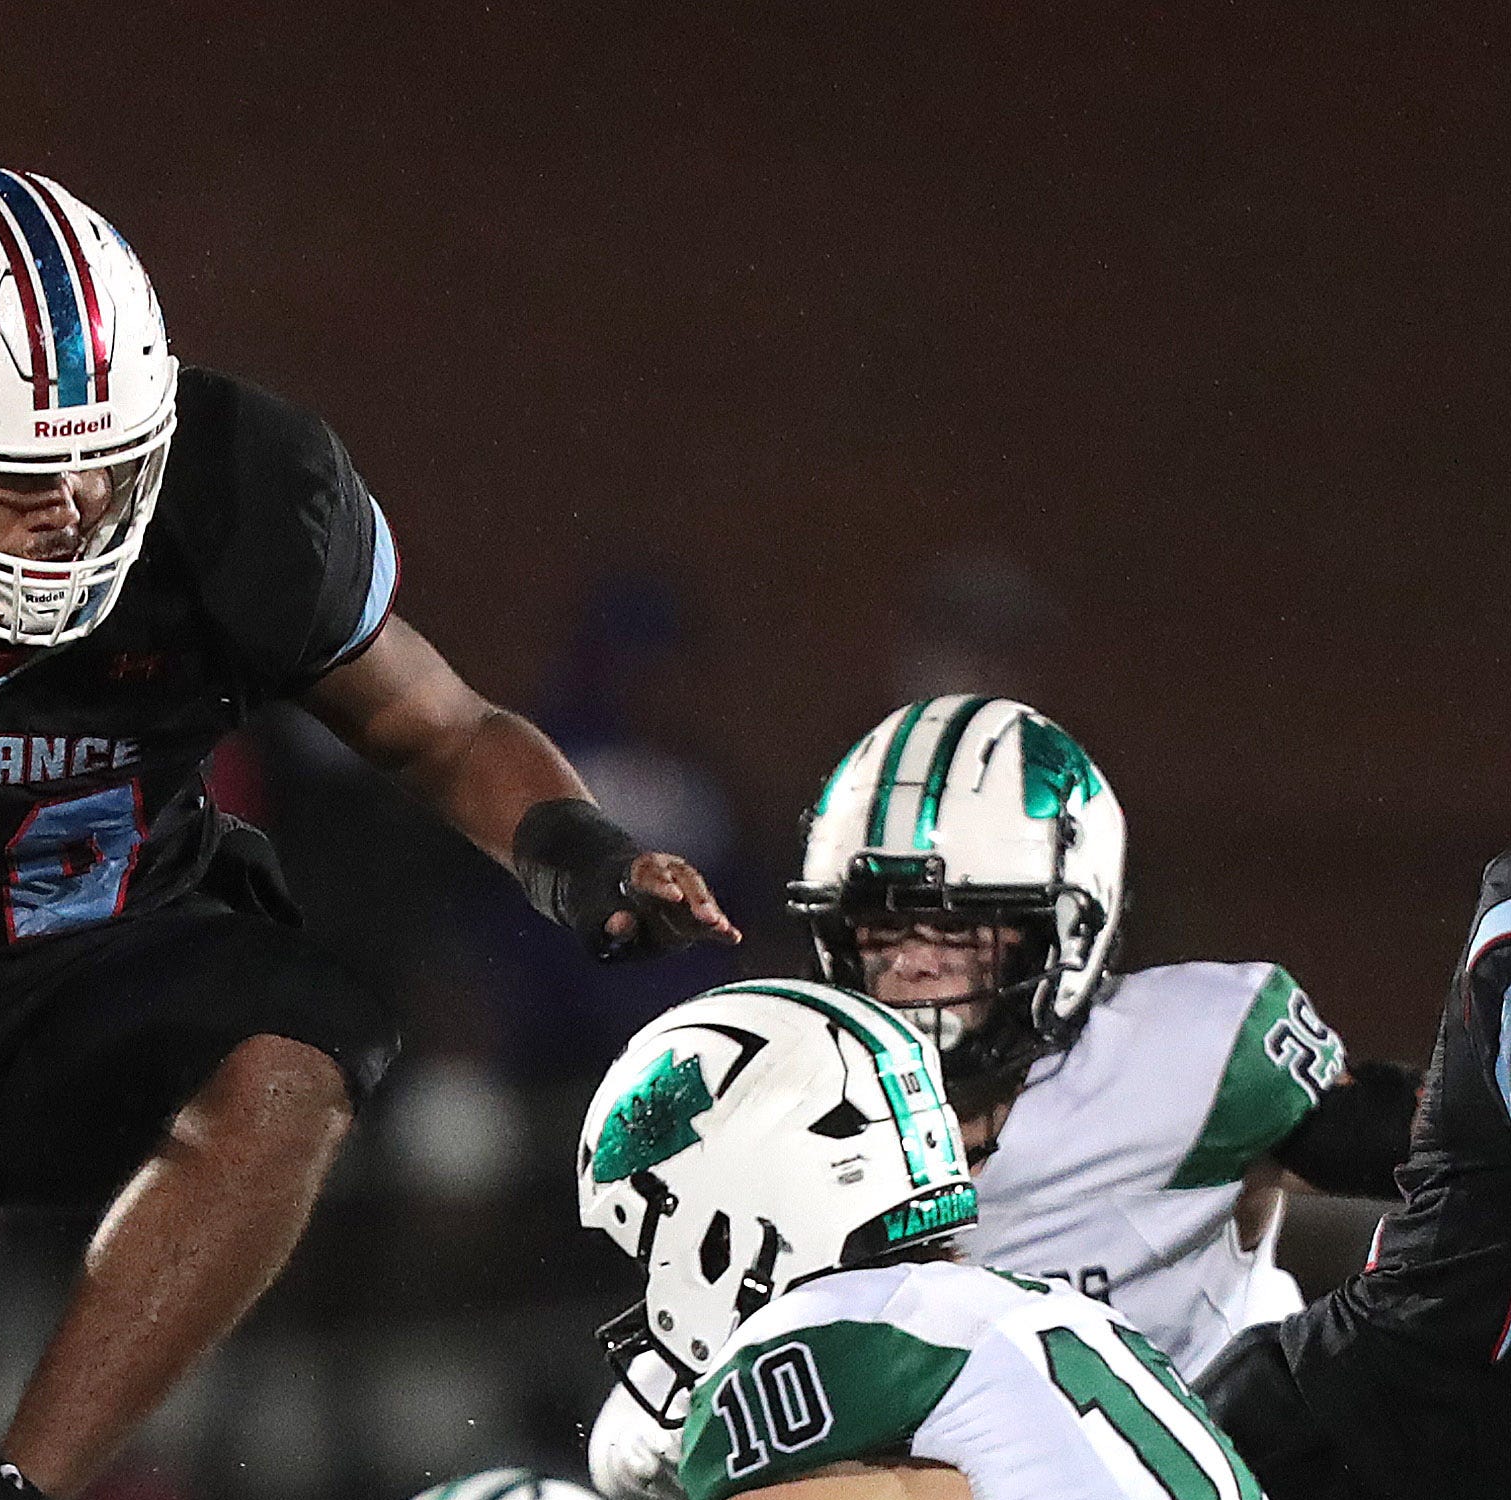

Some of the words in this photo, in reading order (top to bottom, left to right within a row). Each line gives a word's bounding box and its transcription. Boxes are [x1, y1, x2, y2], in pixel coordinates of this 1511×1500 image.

[34, 413, 112, 438] Riddell
[24, 591, 65, 603] Riddell
[900, 1072, 920, 1095] 10
[712, 1340, 834, 1480] 10
